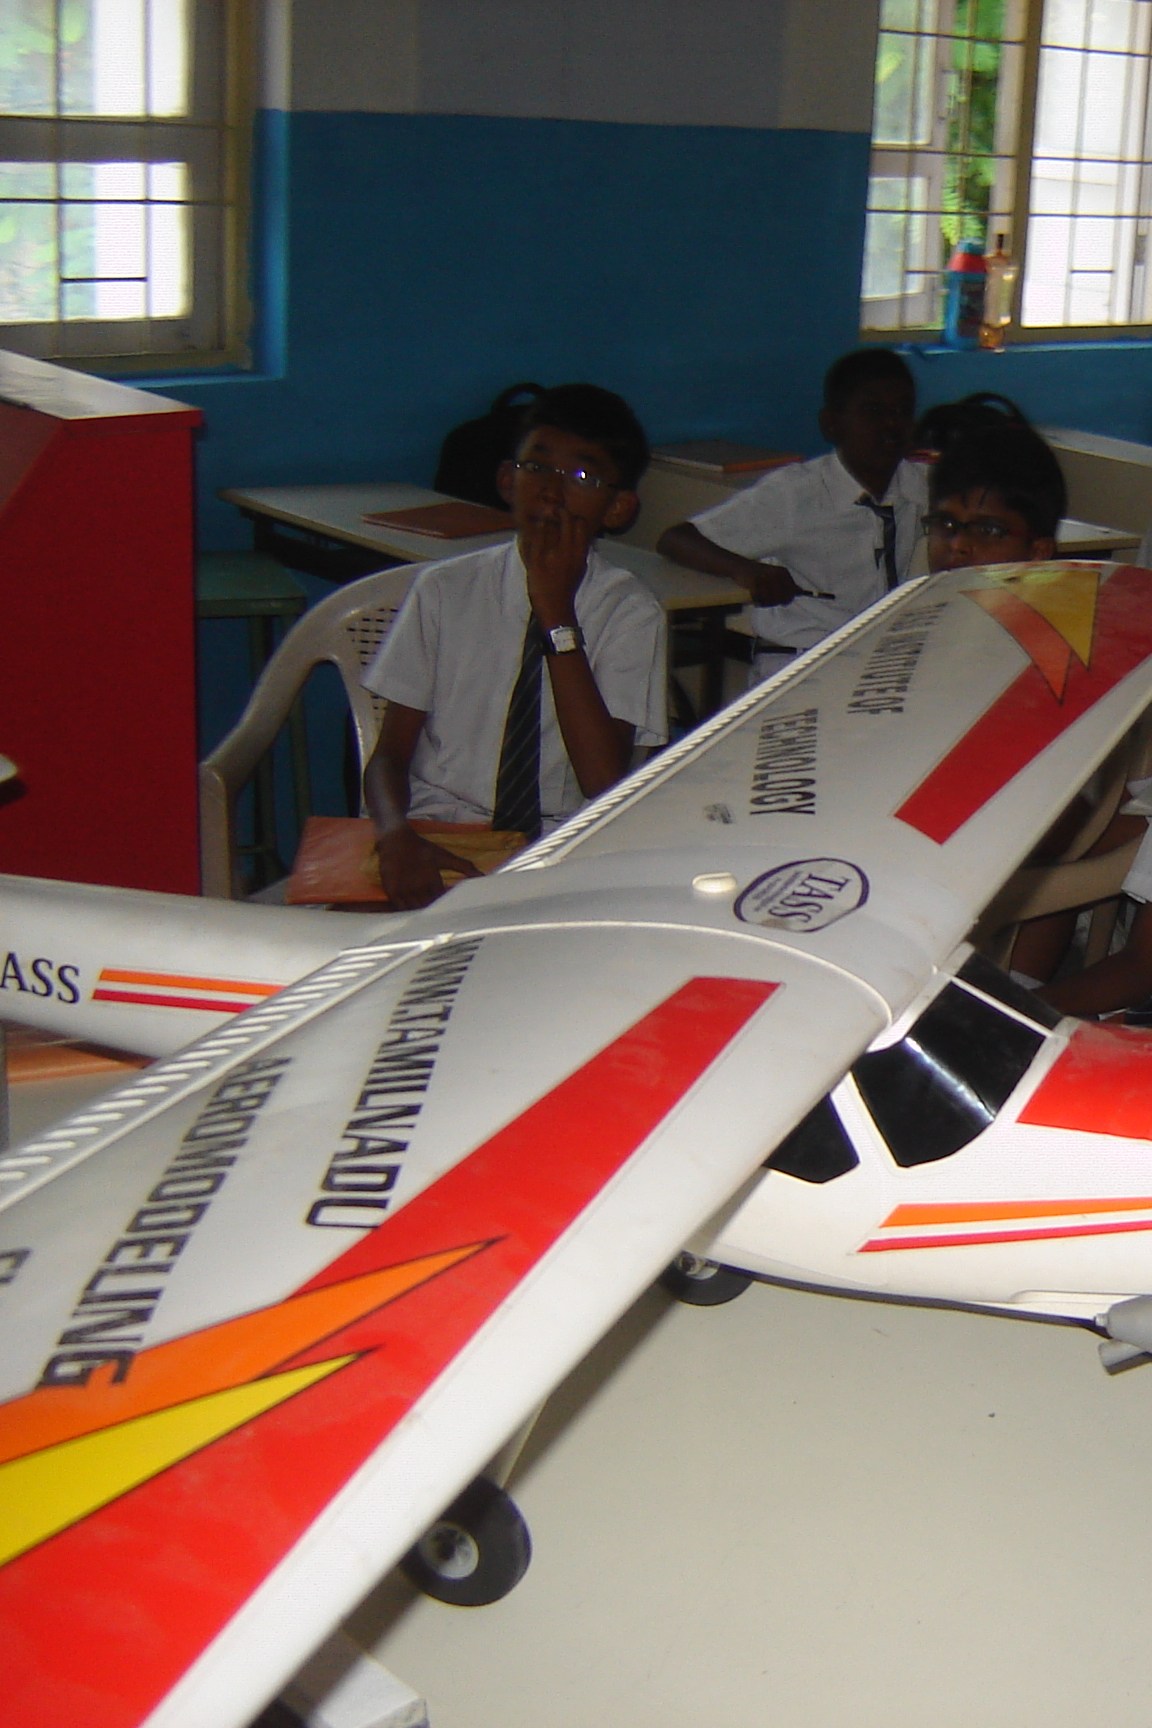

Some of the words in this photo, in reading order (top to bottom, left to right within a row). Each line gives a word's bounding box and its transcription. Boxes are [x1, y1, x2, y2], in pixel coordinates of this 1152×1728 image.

[847, 697, 905, 714] OF
[750, 708, 818, 815] TECHNOLOGY
[768, 873, 851, 923] TASS
[36, 1056, 293, 1389] AEROMODELING
